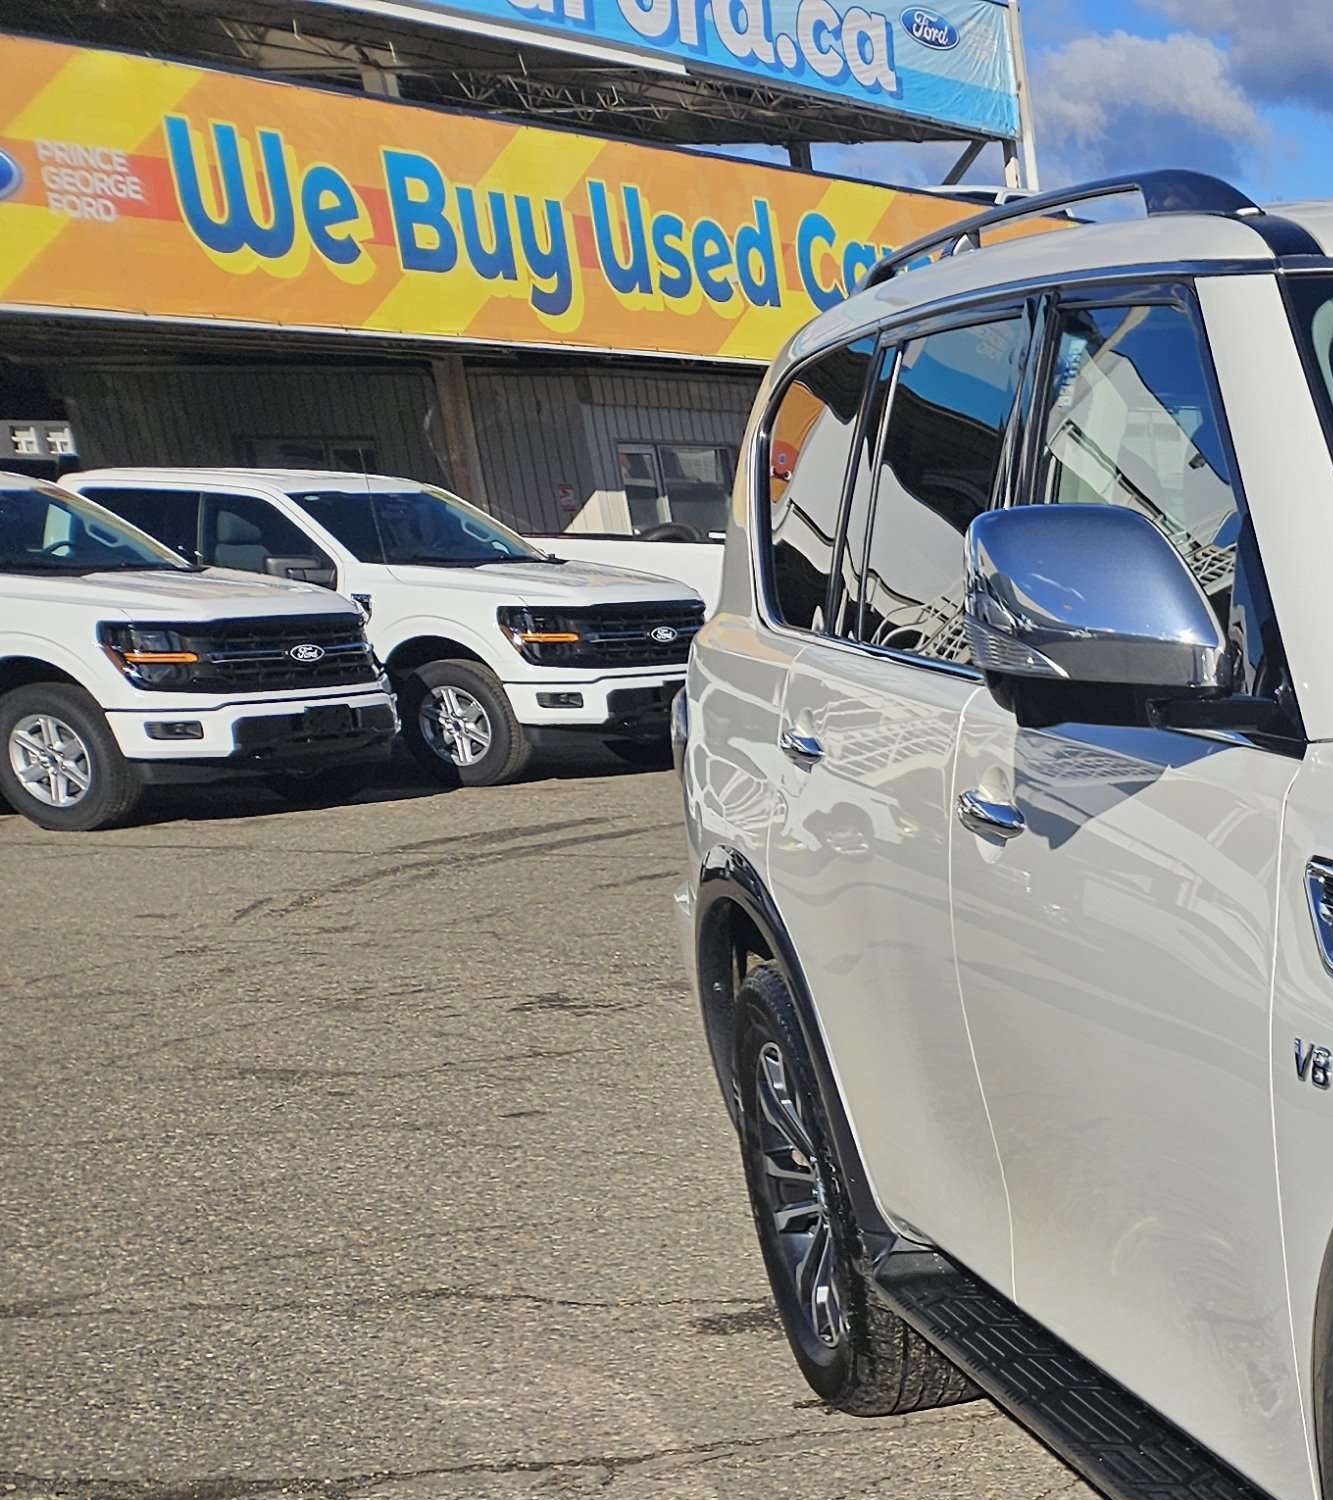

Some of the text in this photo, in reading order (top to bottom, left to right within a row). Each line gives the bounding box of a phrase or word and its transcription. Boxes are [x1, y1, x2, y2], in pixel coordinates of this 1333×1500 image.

[910, 10, 951, 47] Ford
[36, 138, 129, 173] PRINCE
[42, 165, 145, 200] GEORGE
[47, 191, 118, 223] FORD
[165, 114, 936, 317] We Buy Used Ca
[1294, 1038, 1332, 1090] V8
